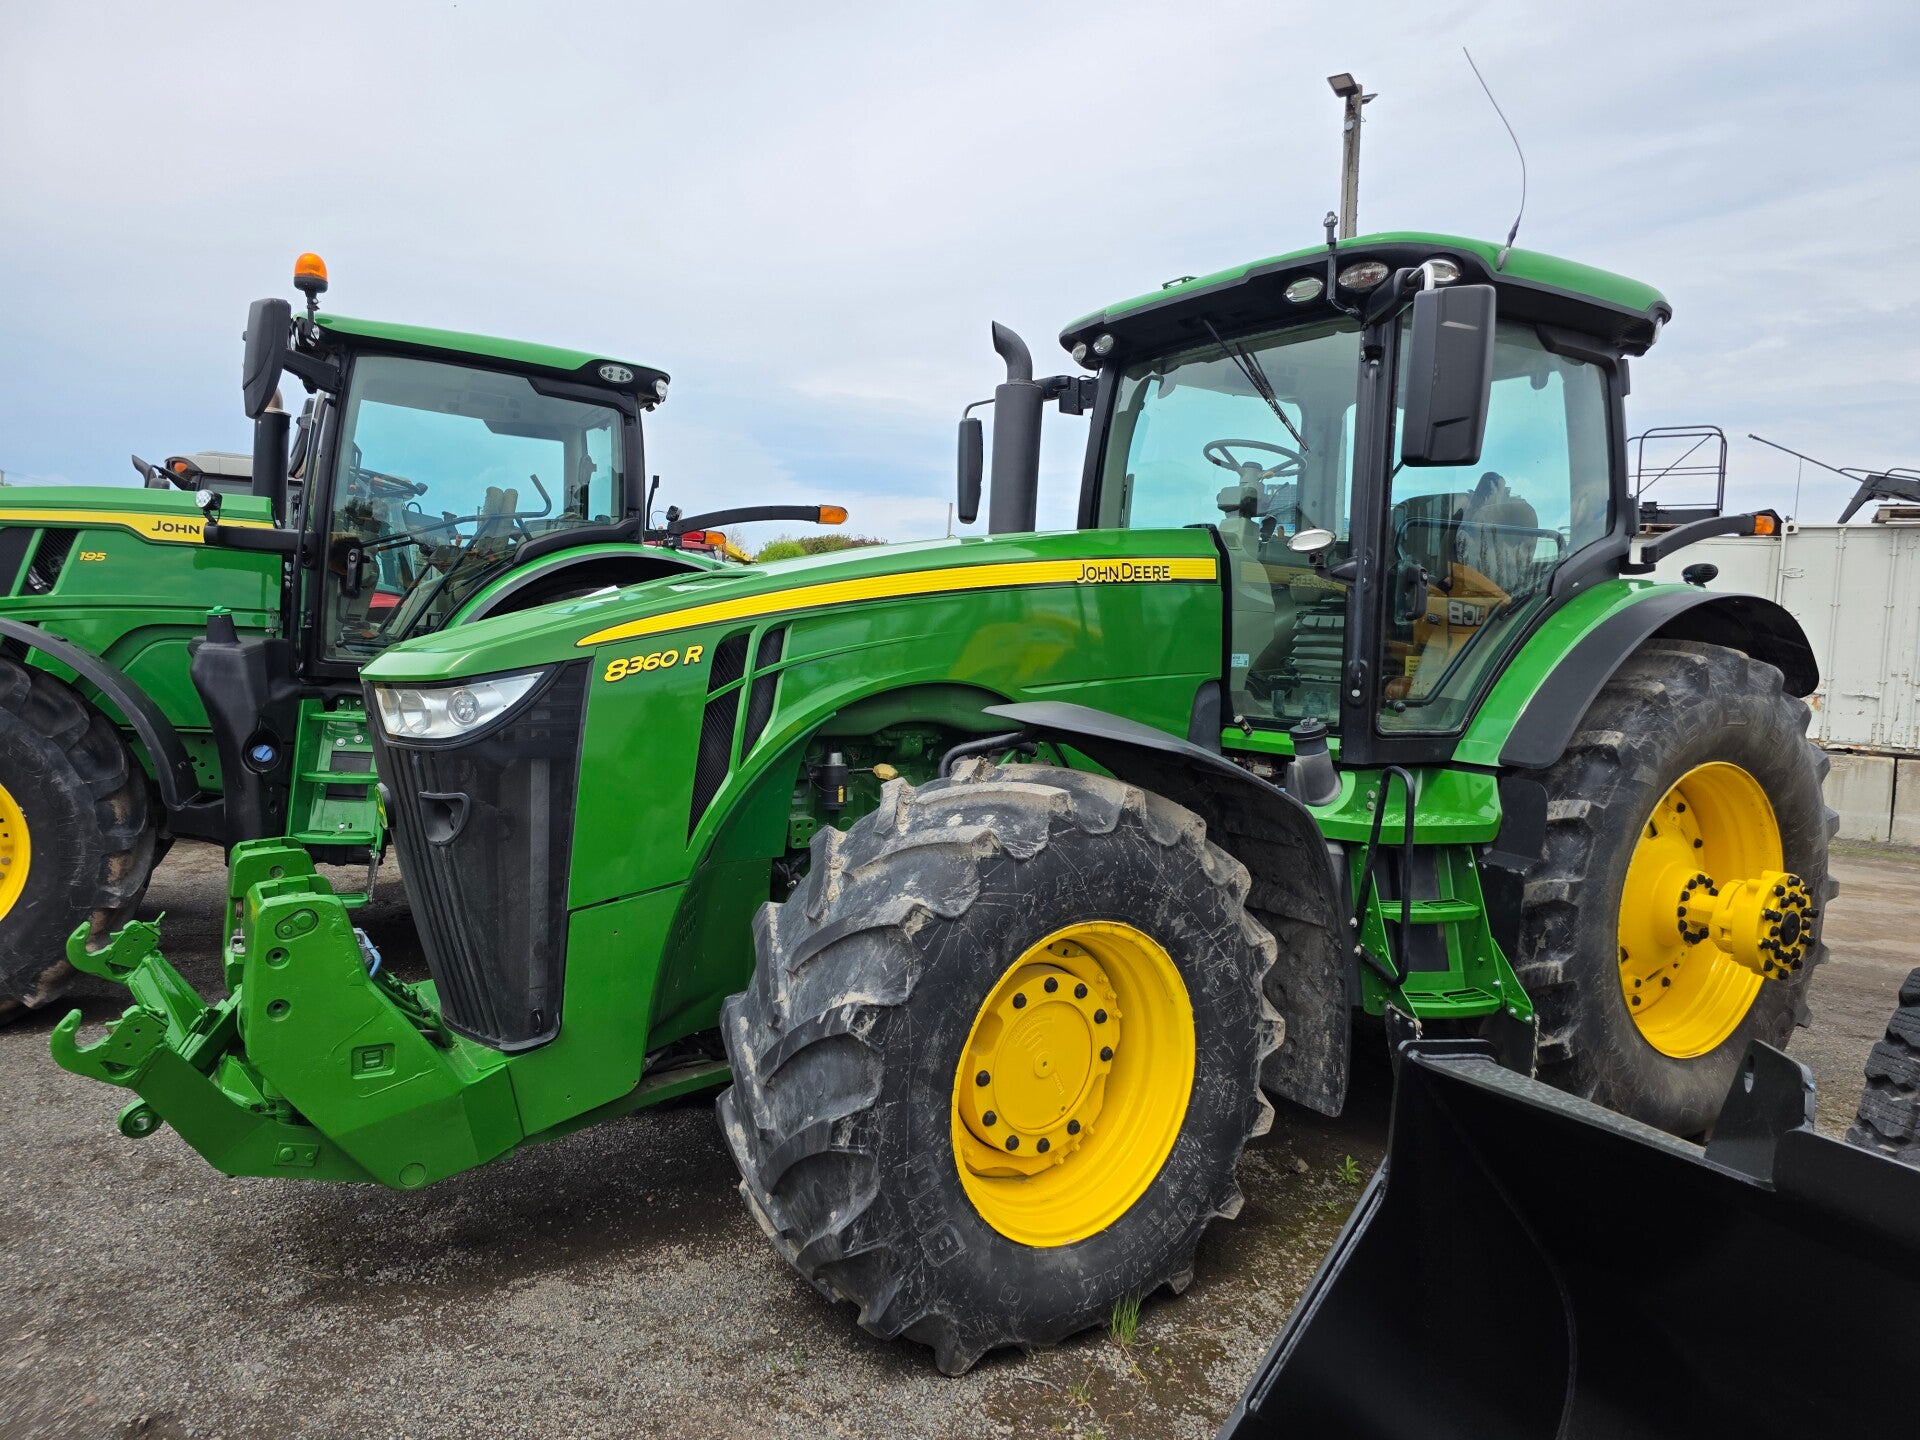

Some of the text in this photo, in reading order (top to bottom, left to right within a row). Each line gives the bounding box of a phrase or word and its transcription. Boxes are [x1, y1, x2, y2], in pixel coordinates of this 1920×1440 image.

[151, 520, 201, 535] JOHN
[79, 551, 107, 562] 195
[1077, 562, 1171, 581] JOHN DEERE
[604, 645, 704, 682] 8360 R
